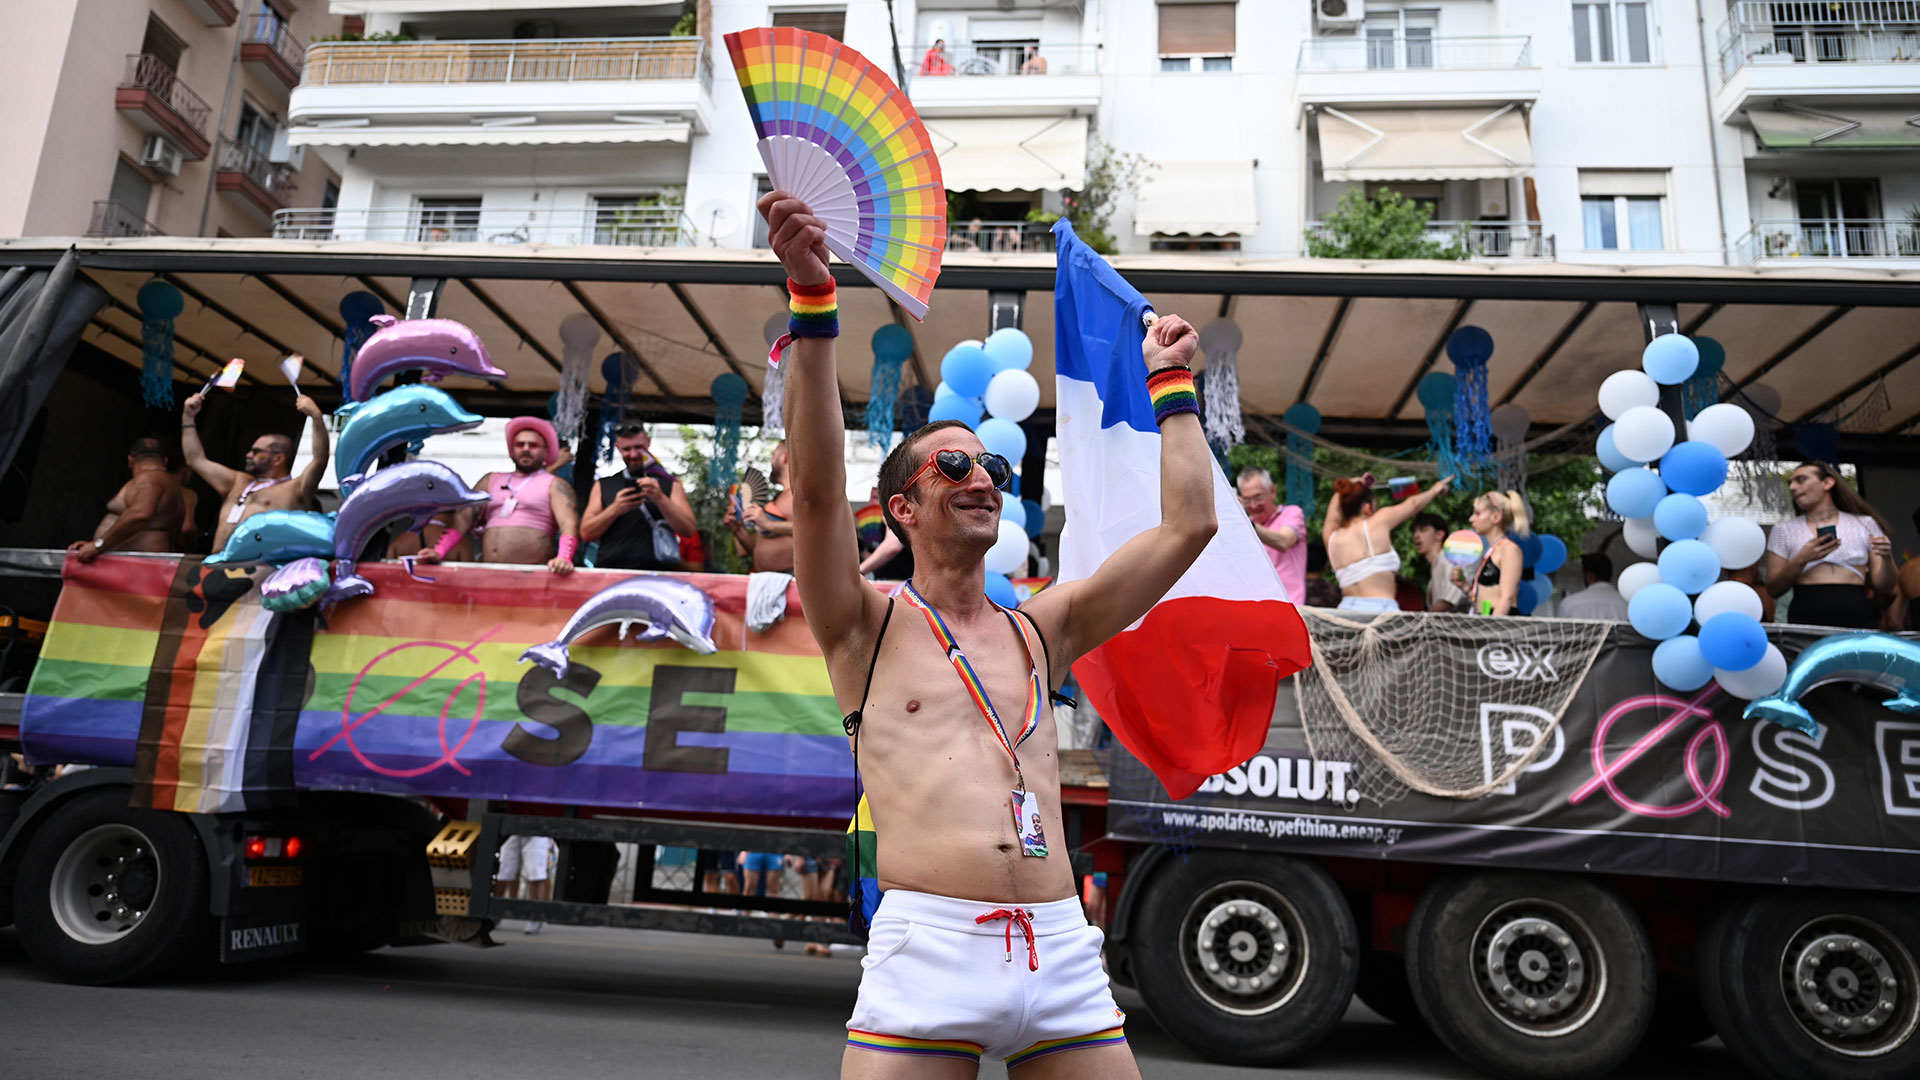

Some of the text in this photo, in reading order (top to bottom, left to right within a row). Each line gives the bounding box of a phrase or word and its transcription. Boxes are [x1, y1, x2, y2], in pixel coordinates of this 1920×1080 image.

[1477, 641, 1560, 682] ex
[1163, 811, 1403, 844] www.apolafste.ypefthina.eneap.gr
[231, 922, 299, 948] RENAULT
